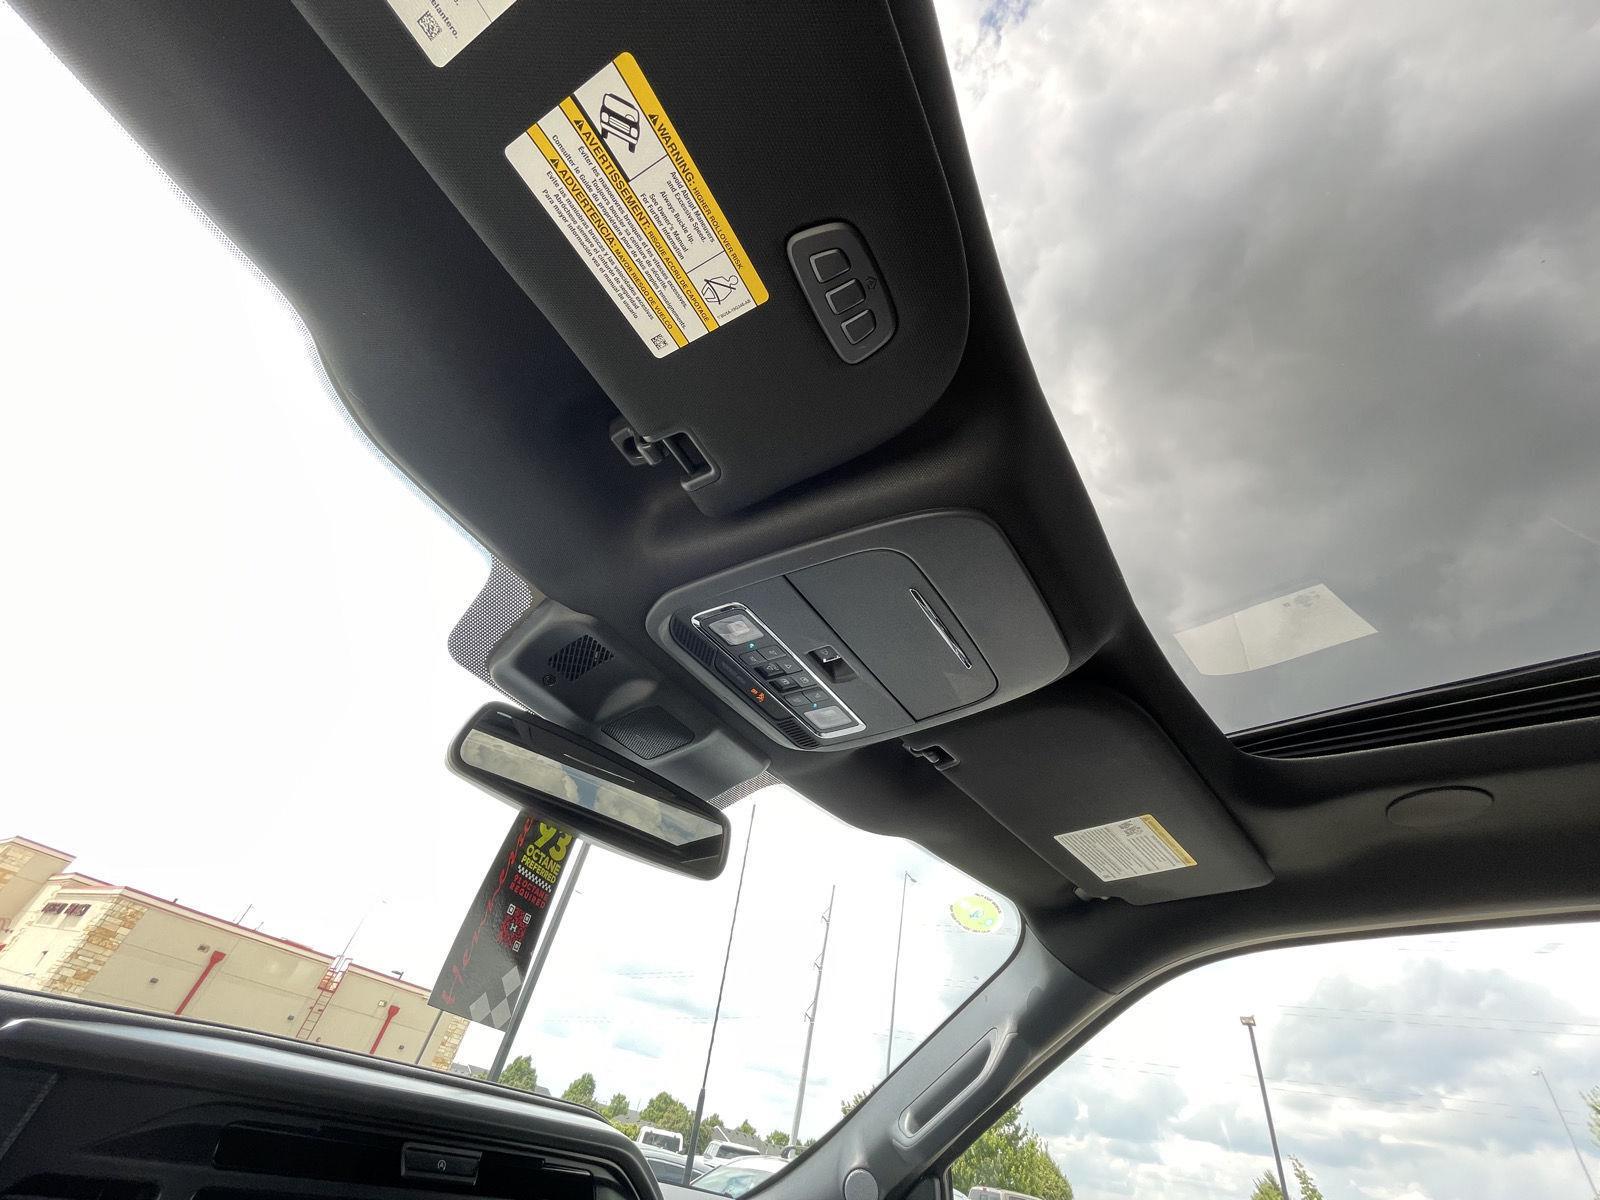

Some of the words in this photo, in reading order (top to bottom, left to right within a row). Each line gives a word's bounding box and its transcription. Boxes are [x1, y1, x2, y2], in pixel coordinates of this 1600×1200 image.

[640, 193, 650, 204] For
[647, 204, 664, 227] Further
[657, 123, 695, 186] WARNING:
[692, 186, 712, 216] HIGHER
[709, 215, 734, 253] ROLLOVER
[731, 252, 744, 270] RISK
[660, 191, 675, 213] Always
[673, 212, 689, 234] Buckle
[666, 180, 677, 193] and
[674, 192, 694, 222] Excessive
[692, 222, 706, 243] Speed.
[670, 171, 684, 189] Avoid
[678, 189, 697, 211] Abrupt
[693, 210, 715, 243] Maneuvers
[582, 131, 651, 230] AVERTISSEMENT:
[647, 230, 667, 257] RISQUE
[664, 257, 682, 280] ACCRU
[679, 279, 689, 289] DE
[686, 289, 710, 322] CAPOTAGE
[649, 193, 659, 206] See
[672, 230, 689, 253] Manual
[558, 169, 616, 248] ADVERTENCIA:
[614, 248, 633, 273] MAYOR
[630, 272, 650, 297] RIESGO
[647, 296, 656, 306] DE
[654, 305, 673, 330] VUELCO
[520, 854, 557, 884] PREFERRED
[526, 844, 561, 876] OCTANE
[509, 881, 546, 909] REQUIRED
[522, 878, 550, 901] OCTANE
